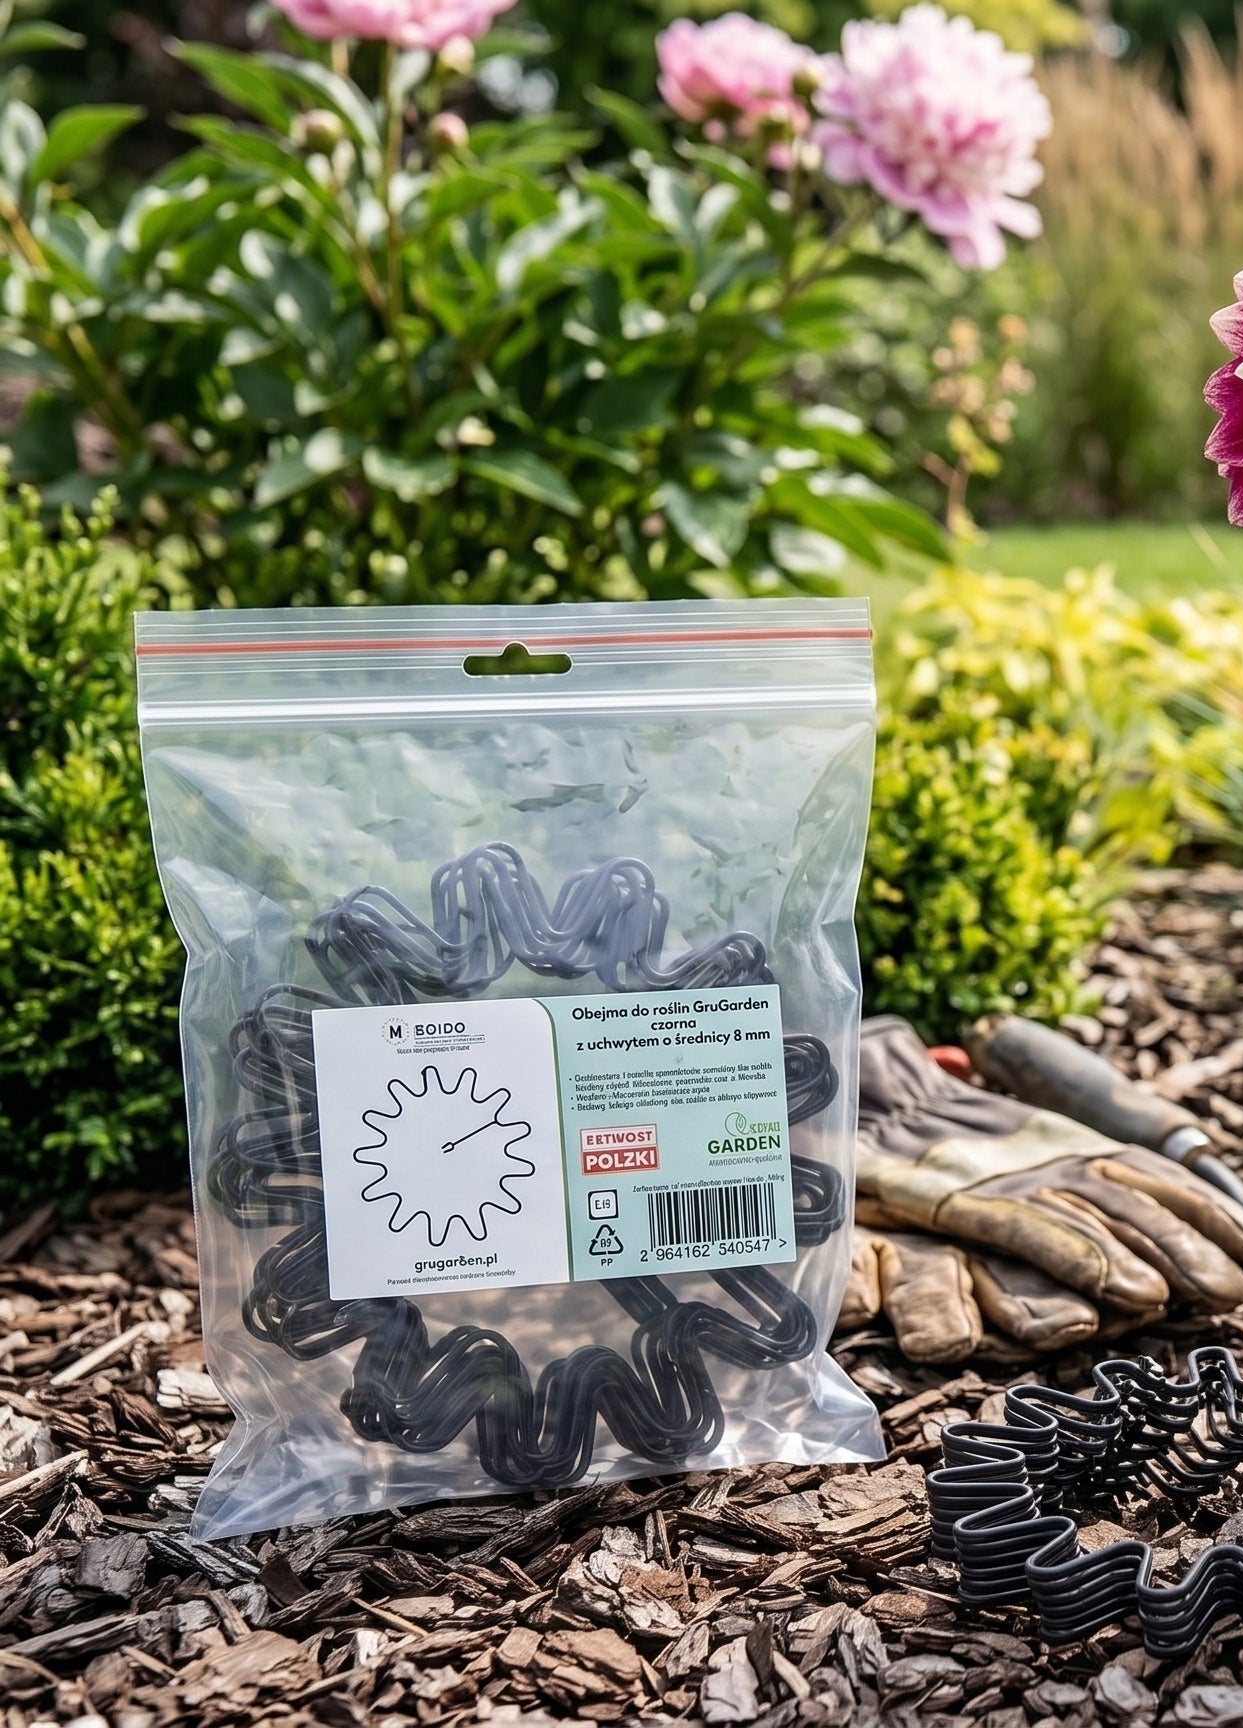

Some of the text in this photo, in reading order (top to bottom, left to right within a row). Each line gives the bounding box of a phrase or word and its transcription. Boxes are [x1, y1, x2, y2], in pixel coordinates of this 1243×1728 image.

[571, 997, 769, 1022] Obejma do roślin GruGarden
[389, 1025, 403, 1039] M
[650, 1019, 697, 1031] czorna
[576, 1029, 771, 1051] z uchwytem o średnicy 8 mm
[707, 1135, 781, 1155] GARDEN
[586, 1149, 656, 1171] POLZKI
[640, 1250, 649, 1263] 2
[655, 1245, 711, 1261] 964162
[718, 1239, 771, 1256] 540547
[600, 1258, 614, 1267] PP
